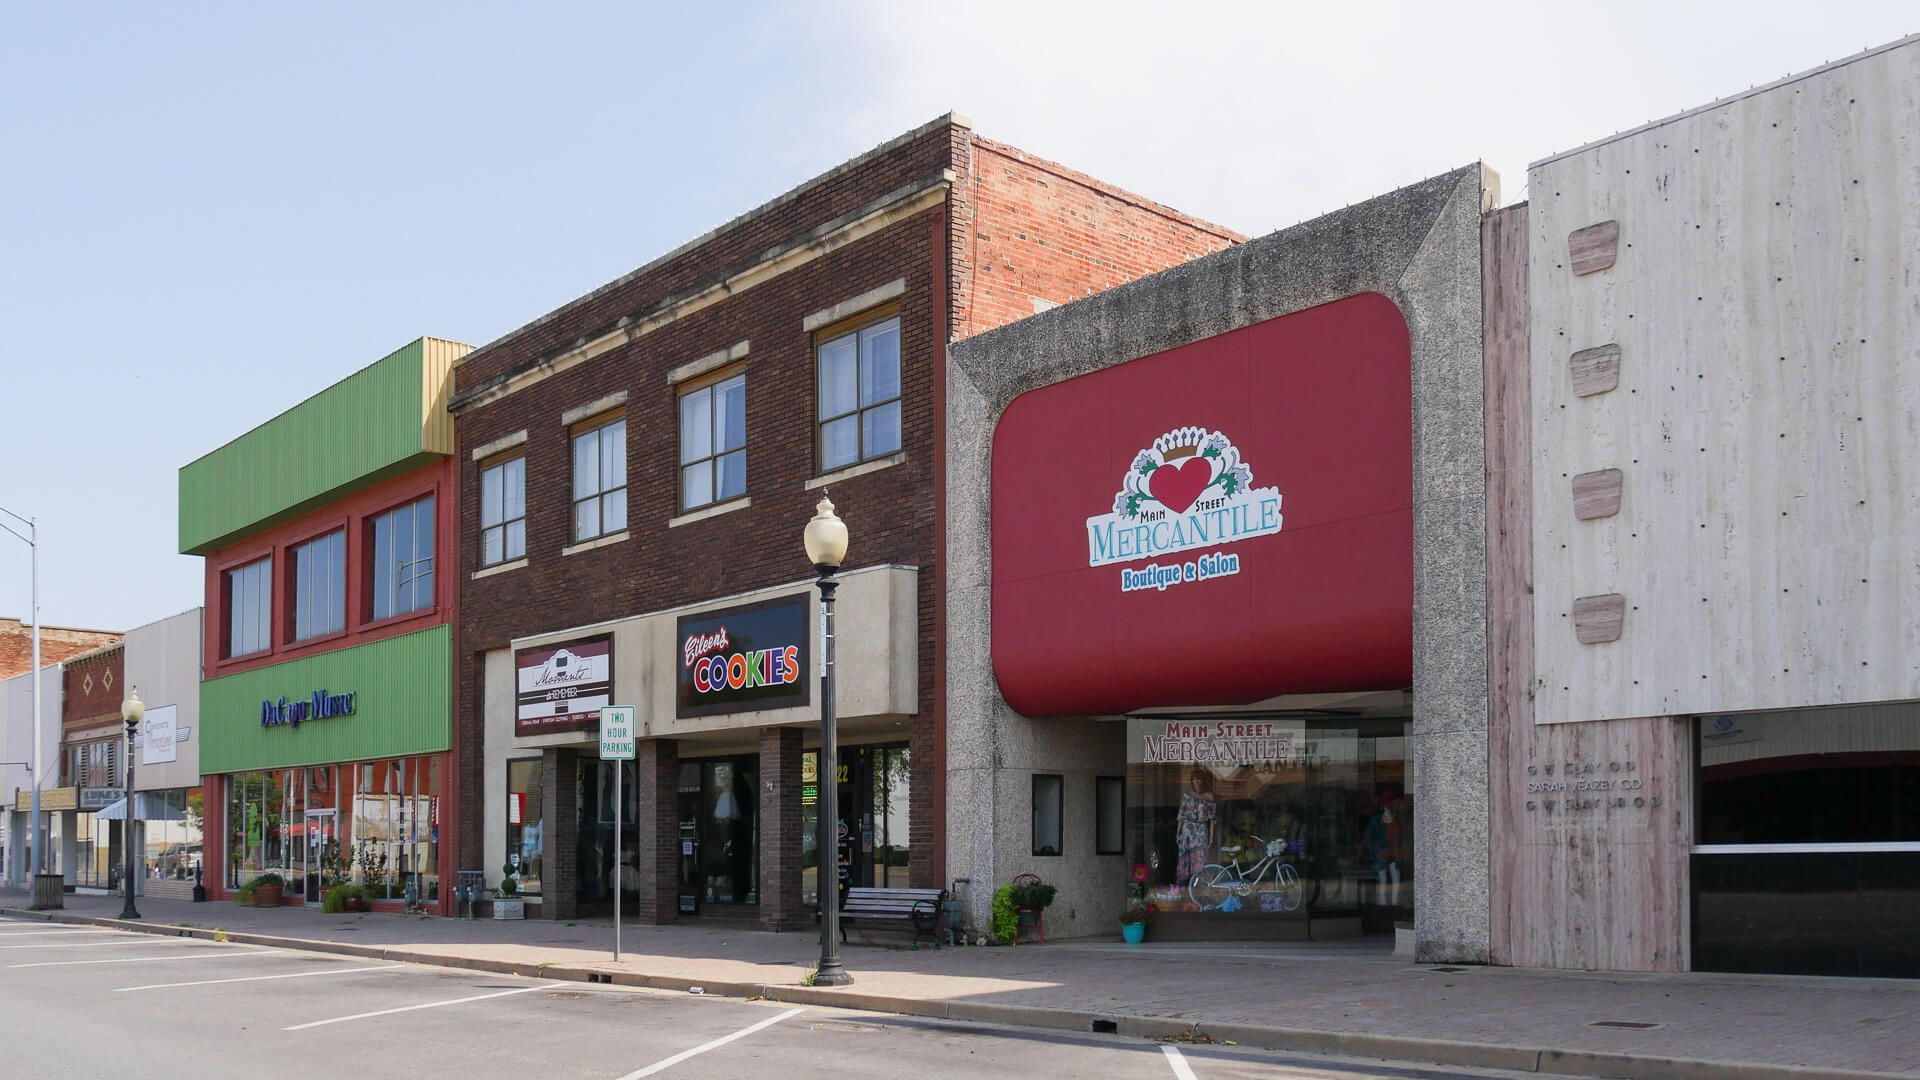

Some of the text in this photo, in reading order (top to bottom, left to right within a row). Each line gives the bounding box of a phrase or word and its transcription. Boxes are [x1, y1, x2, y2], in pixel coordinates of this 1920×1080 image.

[1139, 497, 1226, 523] MAIN STREET
[1091, 498, 1279, 562] MERCANTILE
[1123, 554, 1238, 590] Boutique & Salon
[685, 627, 729, 667] Eileen's
[535, 665, 590, 686] Moments
[694, 645, 799, 694] COOKIES
[310, 688, 354, 720] Music
[611, 712, 625, 724] TWO
[1166, 721, 1273, 738] MAIN STREET
[607, 727, 627, 738] HOUR
[602, 742, 632, 753] PARKING
[1144, 735, 1289, 762] MERCANTILE
[1527, 782, 1568, 794] SARAH
